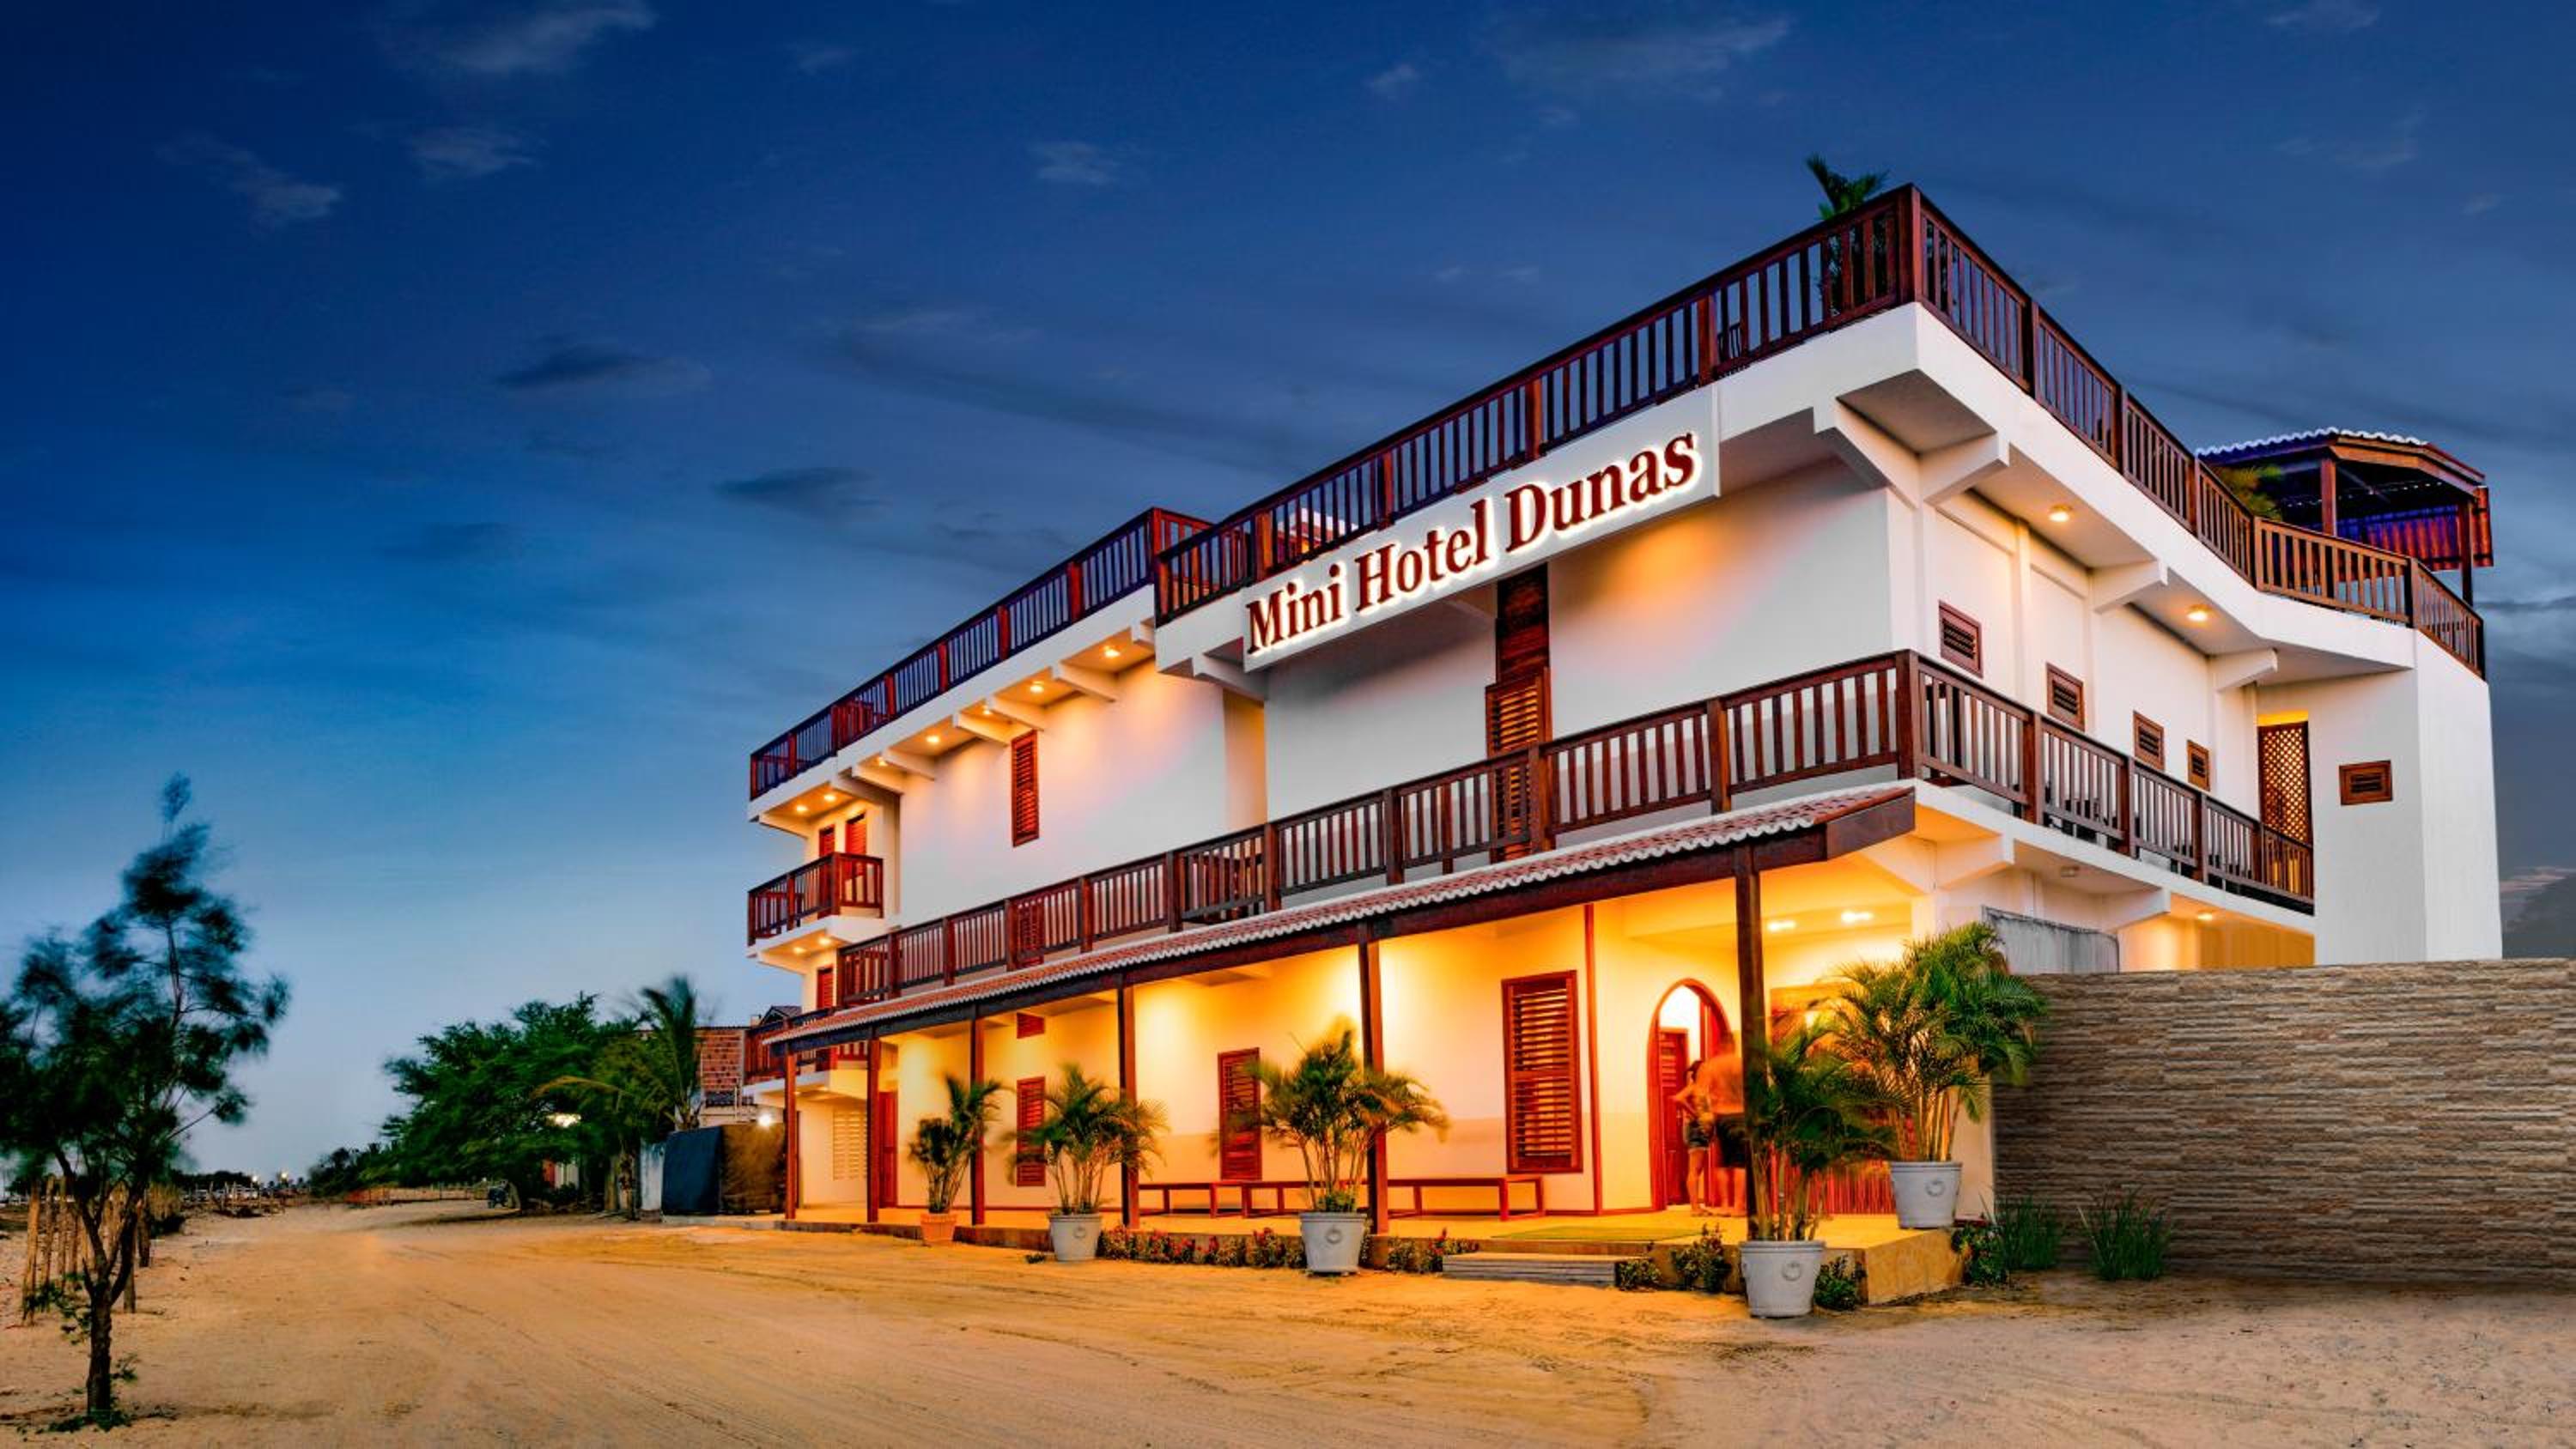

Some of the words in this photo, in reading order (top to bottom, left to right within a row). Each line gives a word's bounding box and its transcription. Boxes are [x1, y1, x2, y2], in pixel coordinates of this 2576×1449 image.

[1246, 565, 1342, 654] Mini
[1355, 499, 1491, 613] Hotel
[1505, 432, 1696, 553] Dunas
